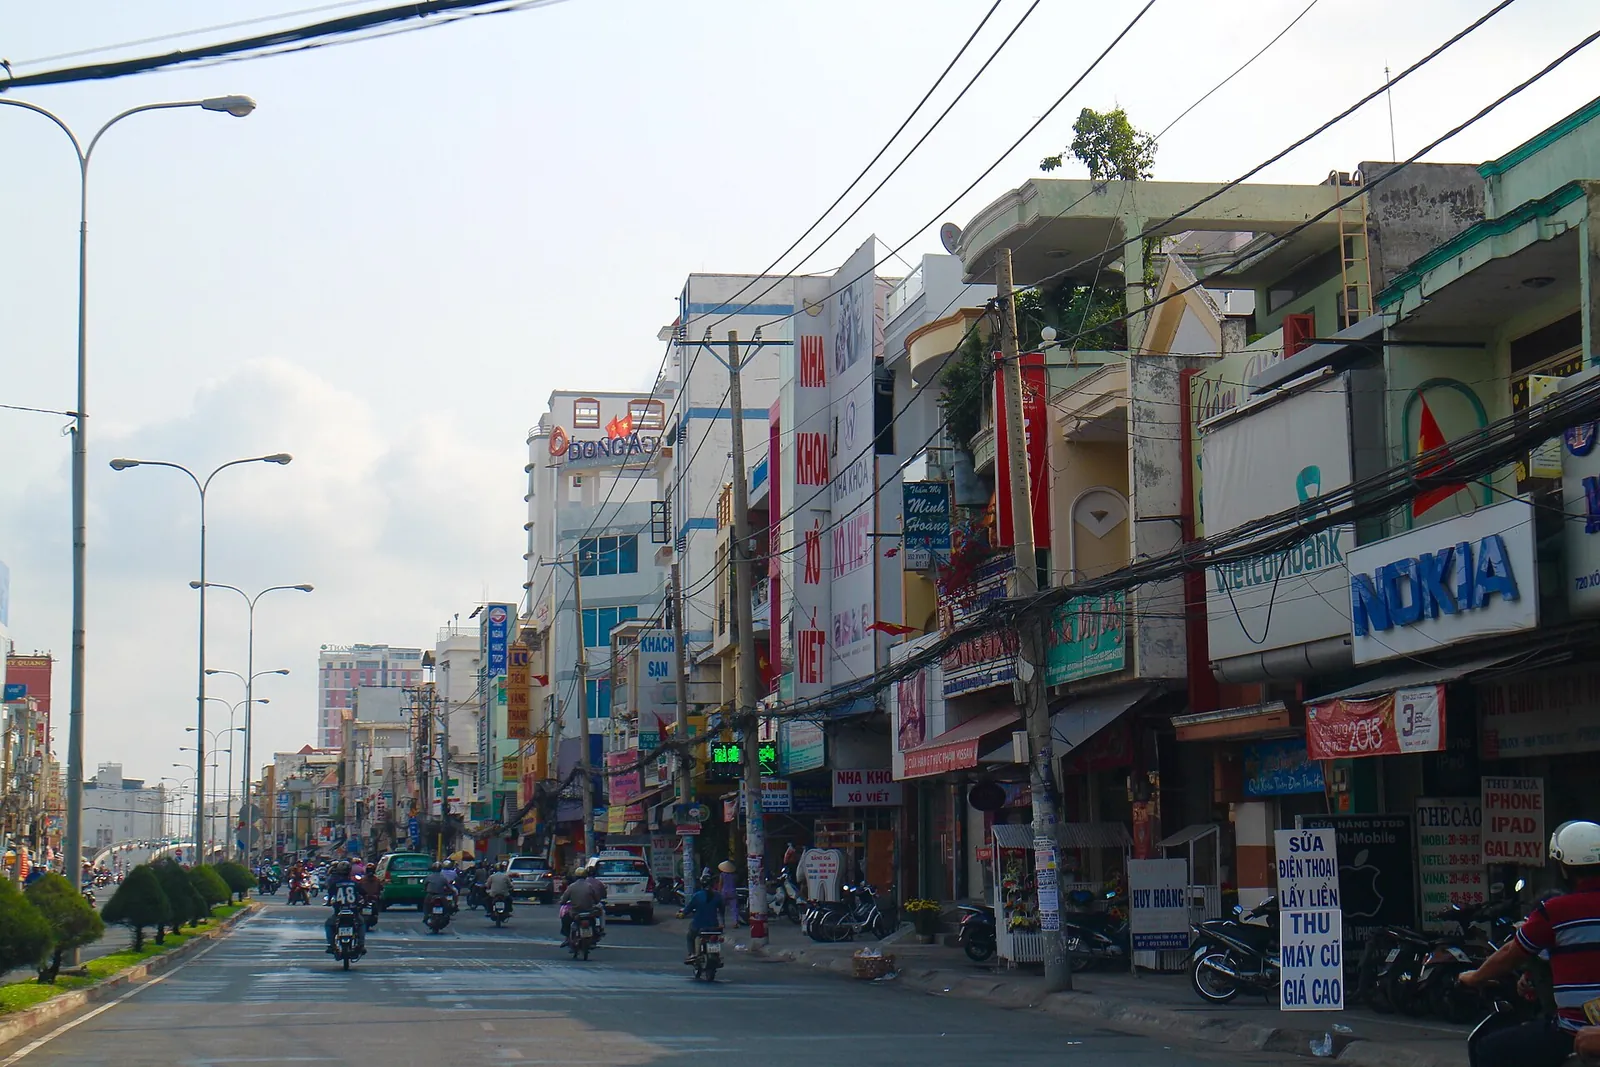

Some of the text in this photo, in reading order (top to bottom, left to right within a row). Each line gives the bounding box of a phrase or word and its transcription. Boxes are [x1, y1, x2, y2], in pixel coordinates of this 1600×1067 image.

[800, 335, 826, 387] NHA
[796, 433, 829, 486] KHOA
[848, 459, 869, 493] KHOA
[908, 497, 945, 514] Minh
[847, 492, 870, 571] VIẾT
[906, 516, 949, 535] Hoàng
[803, 519, 821, 584] XÔ
[1352, 534, 1520, 637] NOKIA
[1575, 575, 1588, 590] 720
[641, 632, 675, 652] KHÁCH
[798, 605, 826, 684] VIẾT
[648, 660, 668, 682] SẠN
[1402, 704, 1414, 737] 3
[1348, 717, 1383, 752] 2015
[837, 771, 900, 785] NHA KHO
[1485, 779, 1539, 789] THU MUA
[847, 790, 862, 802] XÔ
[866, 788, 890, 804] VIẾT
[1485, 793, 1542, 810] IPHONE
[1418, 799, 1482, 827] THẺ CÀO
[1491, 816, 1537, 834] IPAD
[1289, 830, 1325, 852] SỬA
[1484, 841, 1542, 858] GALAXY
[1279, 855, 1335, 882] ĐIỆN THOẠI
[1423, 872, 1449, 885] VINA:
[336, 886, 356, 905] 48
[1133, 883, 1184, 909] HUY HOÀNG
[1281, 881, 1338, 908] LẤY LIỀN
[1290, 912, 1331, 934] THU
[1282, 939, 1341, 968] MÁY CŨ
[1283, 973, 1341, 1006] GIÁ CAO
